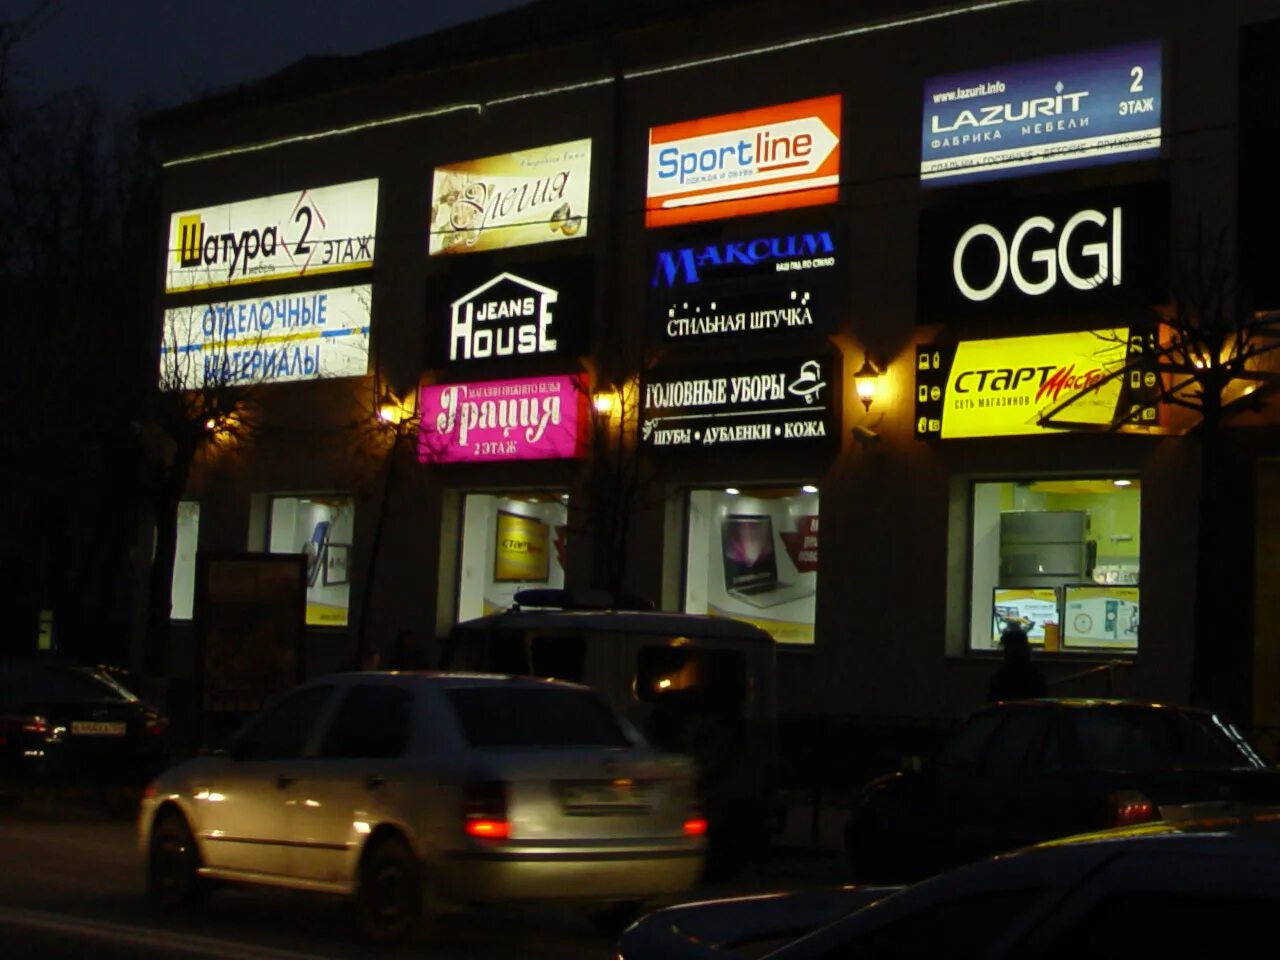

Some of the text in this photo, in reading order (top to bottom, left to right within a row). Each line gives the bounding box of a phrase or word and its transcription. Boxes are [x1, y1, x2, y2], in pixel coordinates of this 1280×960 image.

[933, 80, 1006, 104] www.lazurit.info
[1130, 66, 1144, 93] 2
[1119, 97, 1154, 116] ЭТАЖ
[931, 117, 1089, 148] ФАБРИКА МЕБЕЛИ
[658, 131, 813, 185] Sportline
[180, 222, 278, 278] Шатура
[322, 236, 372, 265] ЭТАЖ
[953, 206, 1122, 301] OGGI
[202, 294, 328, 339] ОТДЕЛОЧНЫЕ
[476, 297, 535, 321] JEANS
[667, 307, 813, 337] СТИЛЬНАЯ ШТУЧКА
[204, 345, 320, 383] МАТЕРИАЛЫ
[645, 373, 786, 409] ГОЛОВНЫЕ УБОРЫ
[954, 395, 1030, 410] СЕТЬ МАГАЗИНОВ
[437, 386, 561, 446] Грация
[481, 440, 518, 454] ЭТАЖ
[653, 420, 826, 445] ШУБЫ ДУБЛЕНКИ КОЖА
